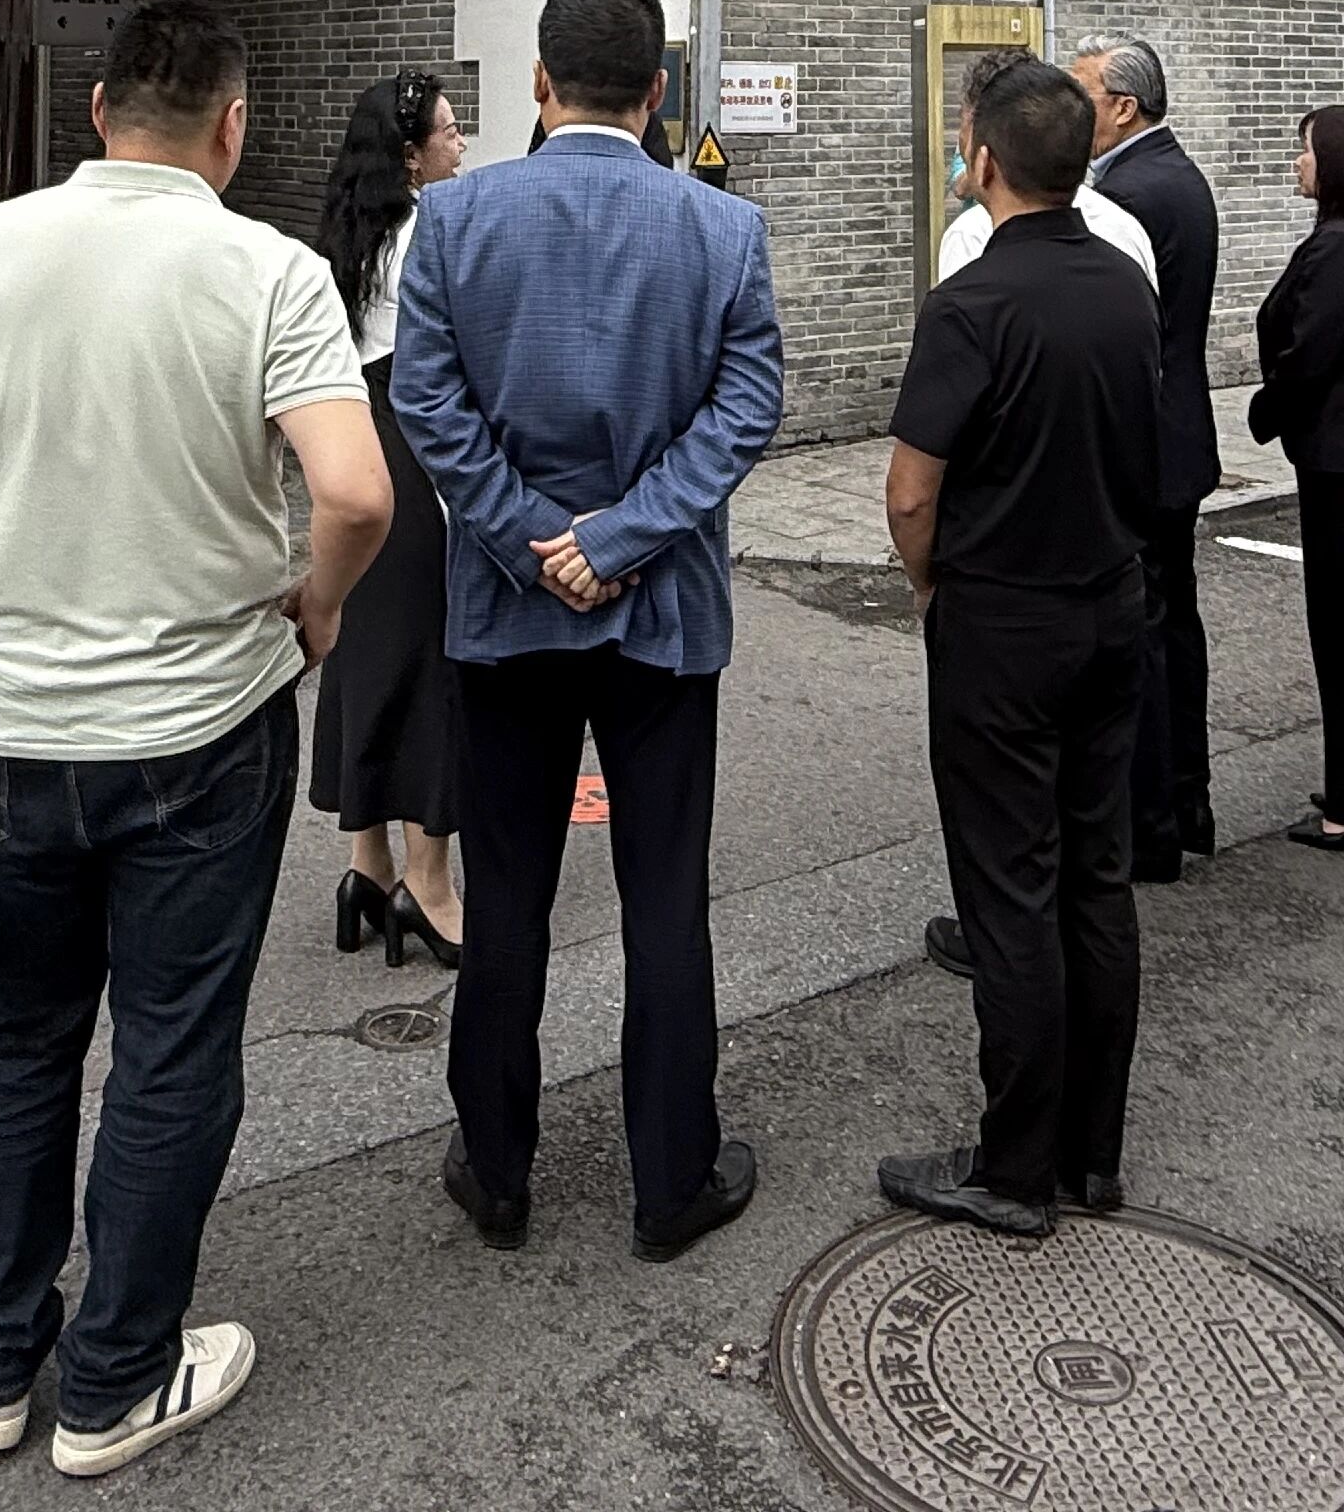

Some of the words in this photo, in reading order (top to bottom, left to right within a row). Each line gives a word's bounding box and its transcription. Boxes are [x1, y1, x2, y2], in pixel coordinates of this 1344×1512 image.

[876, 1272, 1038, 1489] 北京市自来水集团
